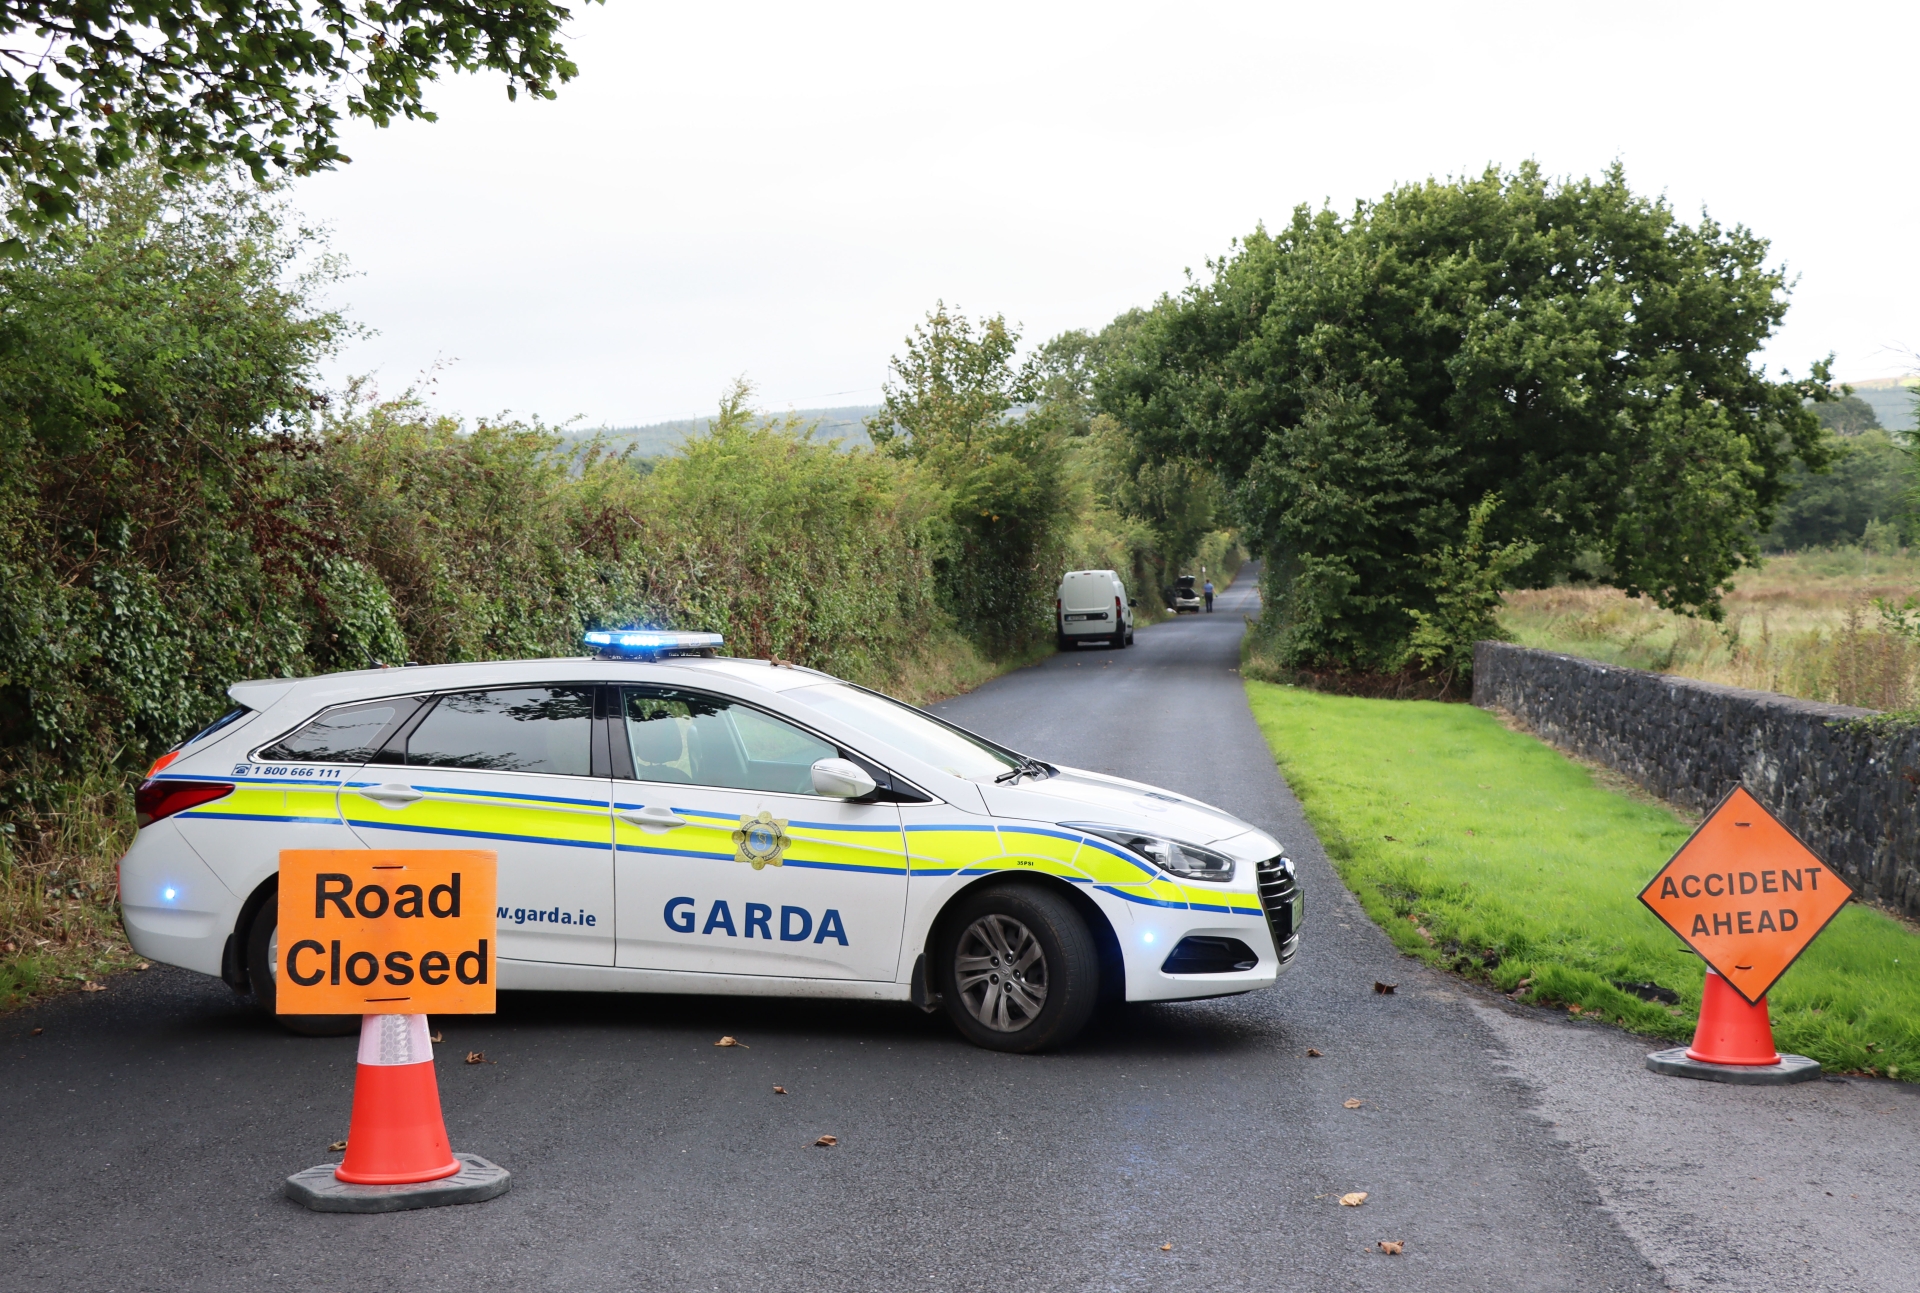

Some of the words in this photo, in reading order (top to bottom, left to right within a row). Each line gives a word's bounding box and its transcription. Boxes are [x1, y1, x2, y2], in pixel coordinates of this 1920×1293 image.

[254, 766, 261, 775] 1
[263, 766, 288, 776] 800
[290, 767, 315, 777] 666
[319, 768, 341, 778] 111
[315, 872, 461, 919] Road
[1660, 867, 1822, 900] ACCIDENT
[663, 896, 849, 947] GARDA
[1691, 908, 1799, 938] AHEAD
[286, 939, 488, 987] Closed
